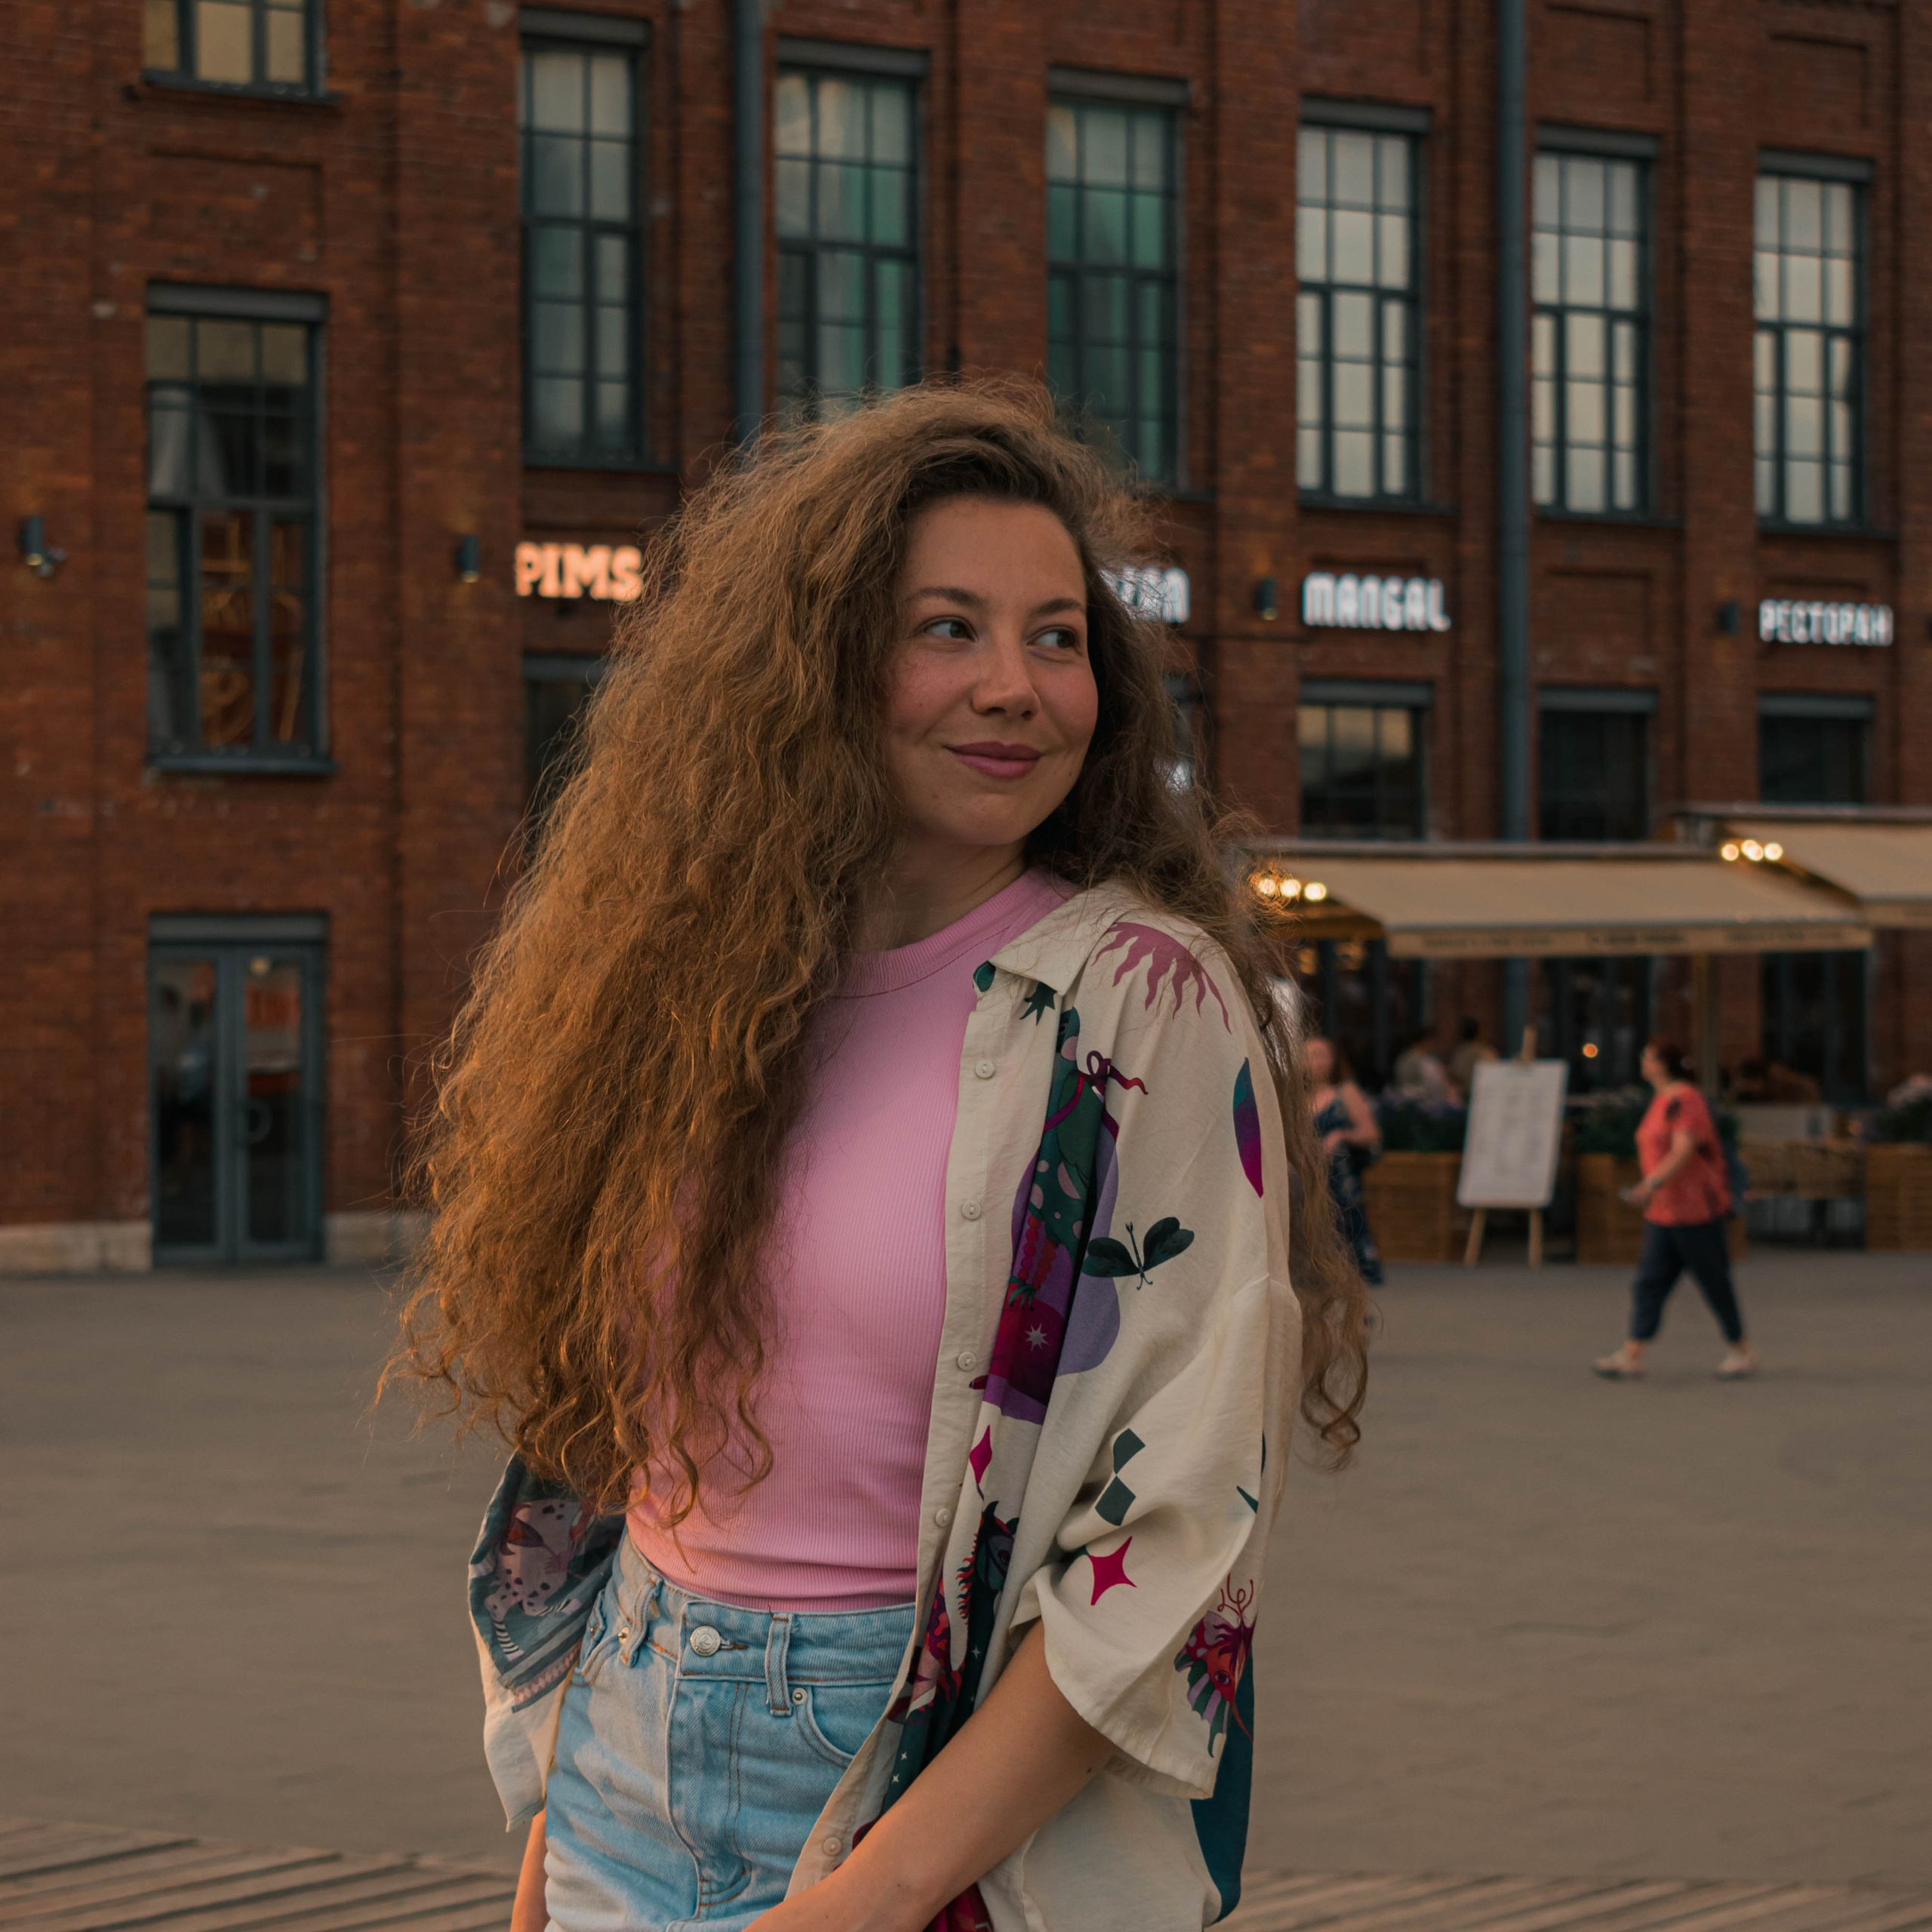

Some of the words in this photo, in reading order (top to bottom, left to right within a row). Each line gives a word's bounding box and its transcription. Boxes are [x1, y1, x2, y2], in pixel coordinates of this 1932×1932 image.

[515, 542, 641, 601] PIMS
[1303, 571, 1451, 632] MANGAL
[1760, 599, 1894, 647] РЕСТОРАН
